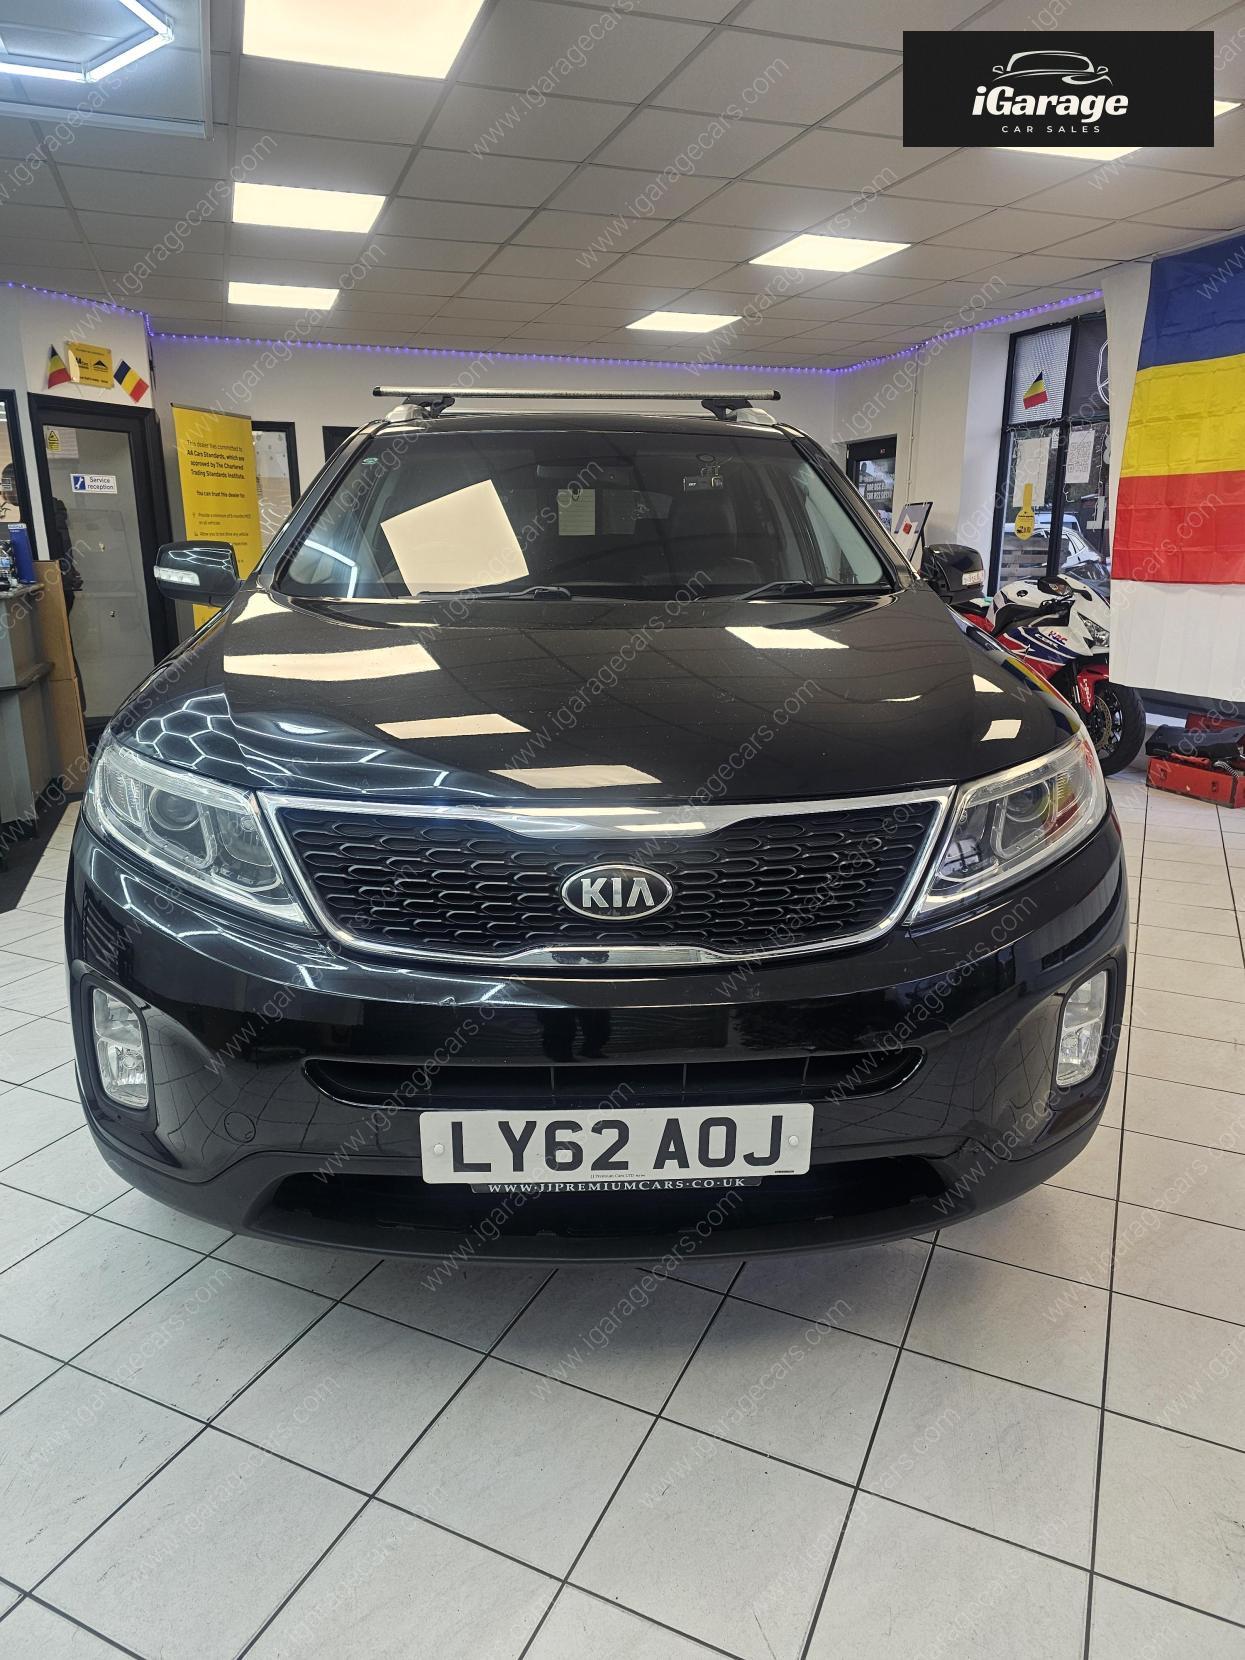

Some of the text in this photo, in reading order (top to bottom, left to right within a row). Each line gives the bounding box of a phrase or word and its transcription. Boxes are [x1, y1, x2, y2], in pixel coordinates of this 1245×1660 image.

[580, 877, 655, 908] KIA
[451, 1114, 784, 1173] LY62 AOJ
